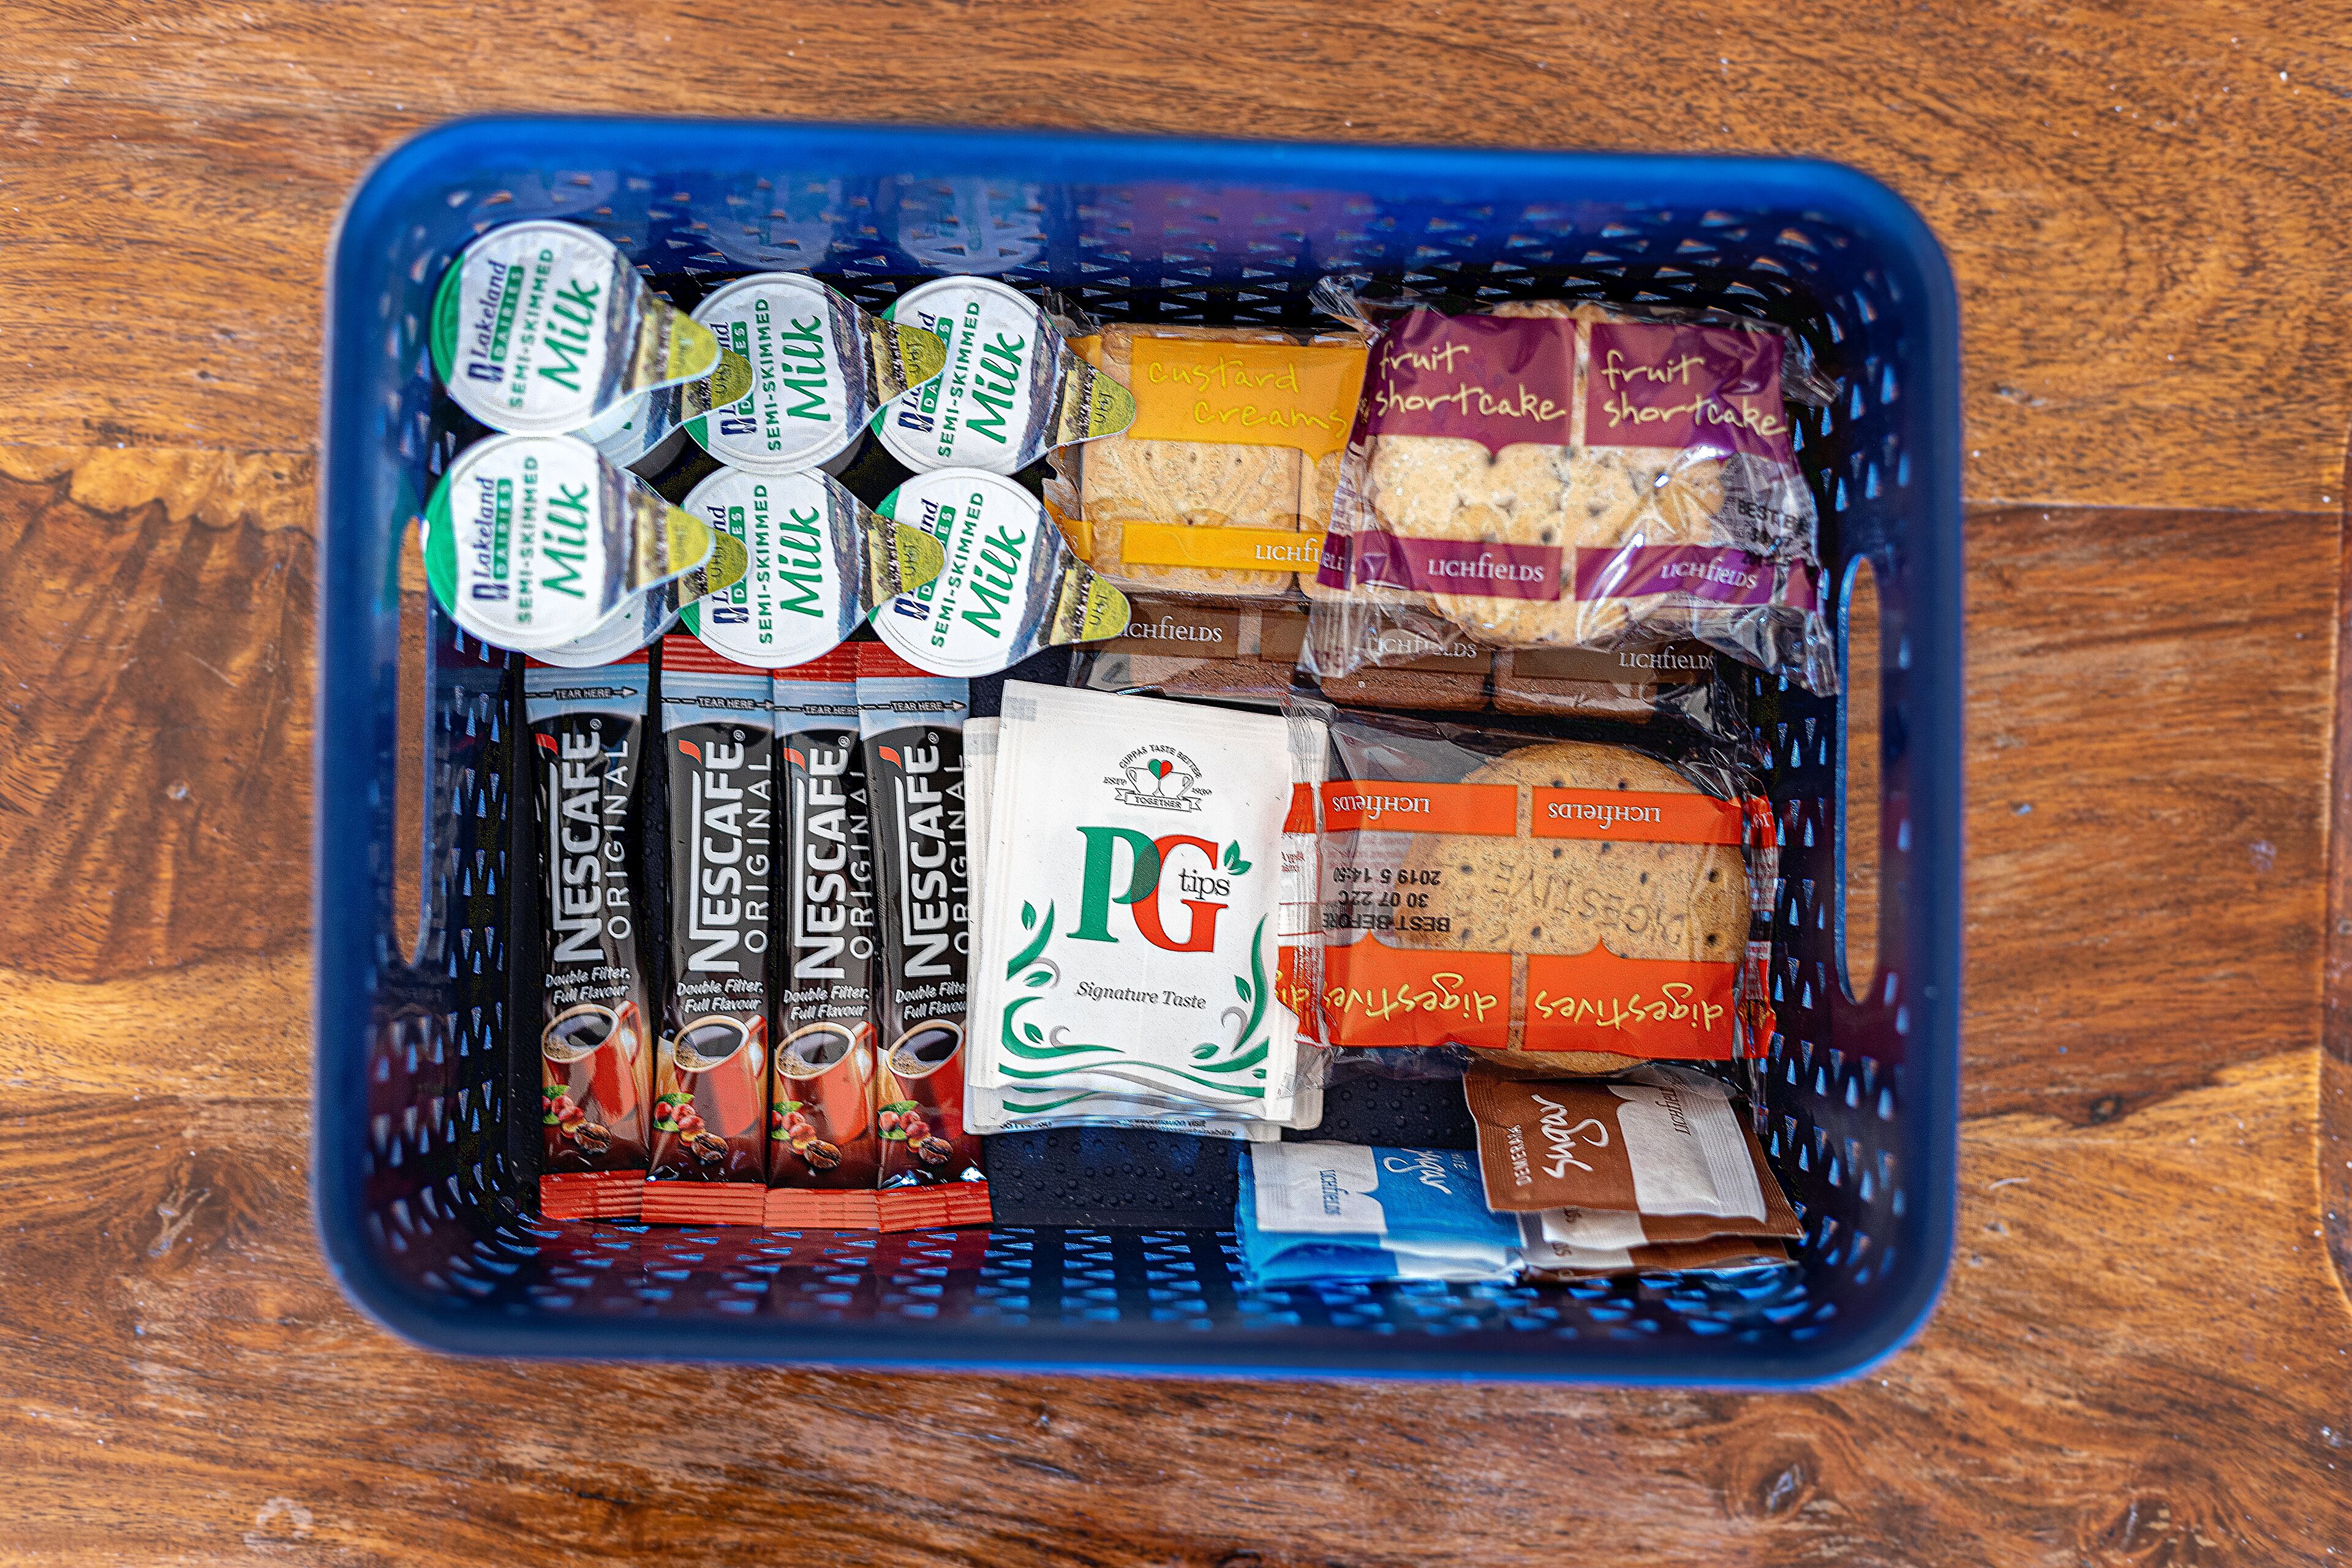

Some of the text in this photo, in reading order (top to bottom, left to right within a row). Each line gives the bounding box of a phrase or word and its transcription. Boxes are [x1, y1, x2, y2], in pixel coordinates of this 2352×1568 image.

[509, 248, 553, 409] SEMI-SKIMMED
[538, 279, 600, 393] Milk
[755, 298, 782, 451] SEMI-SKIMMED
[781, 315, 831, 422] Milk
[1147, 356, 1302, 394] custard
[1379, 339, 1470, 381] fruit
[1600, 349, 1705, 391] fruit
[938, 301, 980, 458] SEMI-SKIMMED
[966, 331, 1025, 445] Milk
[1093, 391, 1114, 424] UHT
[1193, 399, 1349, 440] creams
[1375, 382, 1567, 423] shortcake
[1604, 394, 1789, 437] shortcake
[518, 456, 539, 624] SEMI-SKIMMED
[541, 482, 590, 600] Milk
[753, 484, 774, 645] SEMI-SKIMMED
[779, 505, 824, 619] Milk
[931, 492, 984, 648] SEMI-SKIMMED
[961, 524, 1027, 639] Milk
[1090, 594, 1109, 627] UHT
[556, 687, 612, 699] TEAR HERE
[698, 697, 756, 709] TEAR HERE
[803, 706, 831, 715] TEAR
[892, 701, 943, 712] TEAR HERE
[1148, 744, 1177, 756] TASTE
[1134, 796, 1183, 809] TOGETHER
[604, 740, 632, 940] ORIGINAL
[745, 753, 771, 954] ORIGINAL
[1066, 826, 1229, 953] PG
[1177, 867, 1231, 901] tips
[1380, 868, 1392, 885] 5
[1397, 868, 1442, 886] 2019
[1377, 891, 1401, 908] 07
[1406, 892, 1430, 908] 30
[1321, 912, 1450, 932] BEST BEFORE
[545, 968, 589, 988] Double
[553, 985, 630, 1005] Full Flavour
[676, 980, 722, 997] Double
[783, 987, 829, 1004] Double
[895, 981, 967, 1004] Double Filte
[1076, 981, 1207, 1010] Signature Taste
[684, 997, 762, 1014] Full Flavour
[790, 1004, 869, 1021] Full Flavour
[903, 1003, 928, 1020] Full
[1534, 981, 1725, 1032] digestives
[1531, 1093, 1610, 1180] sugar
